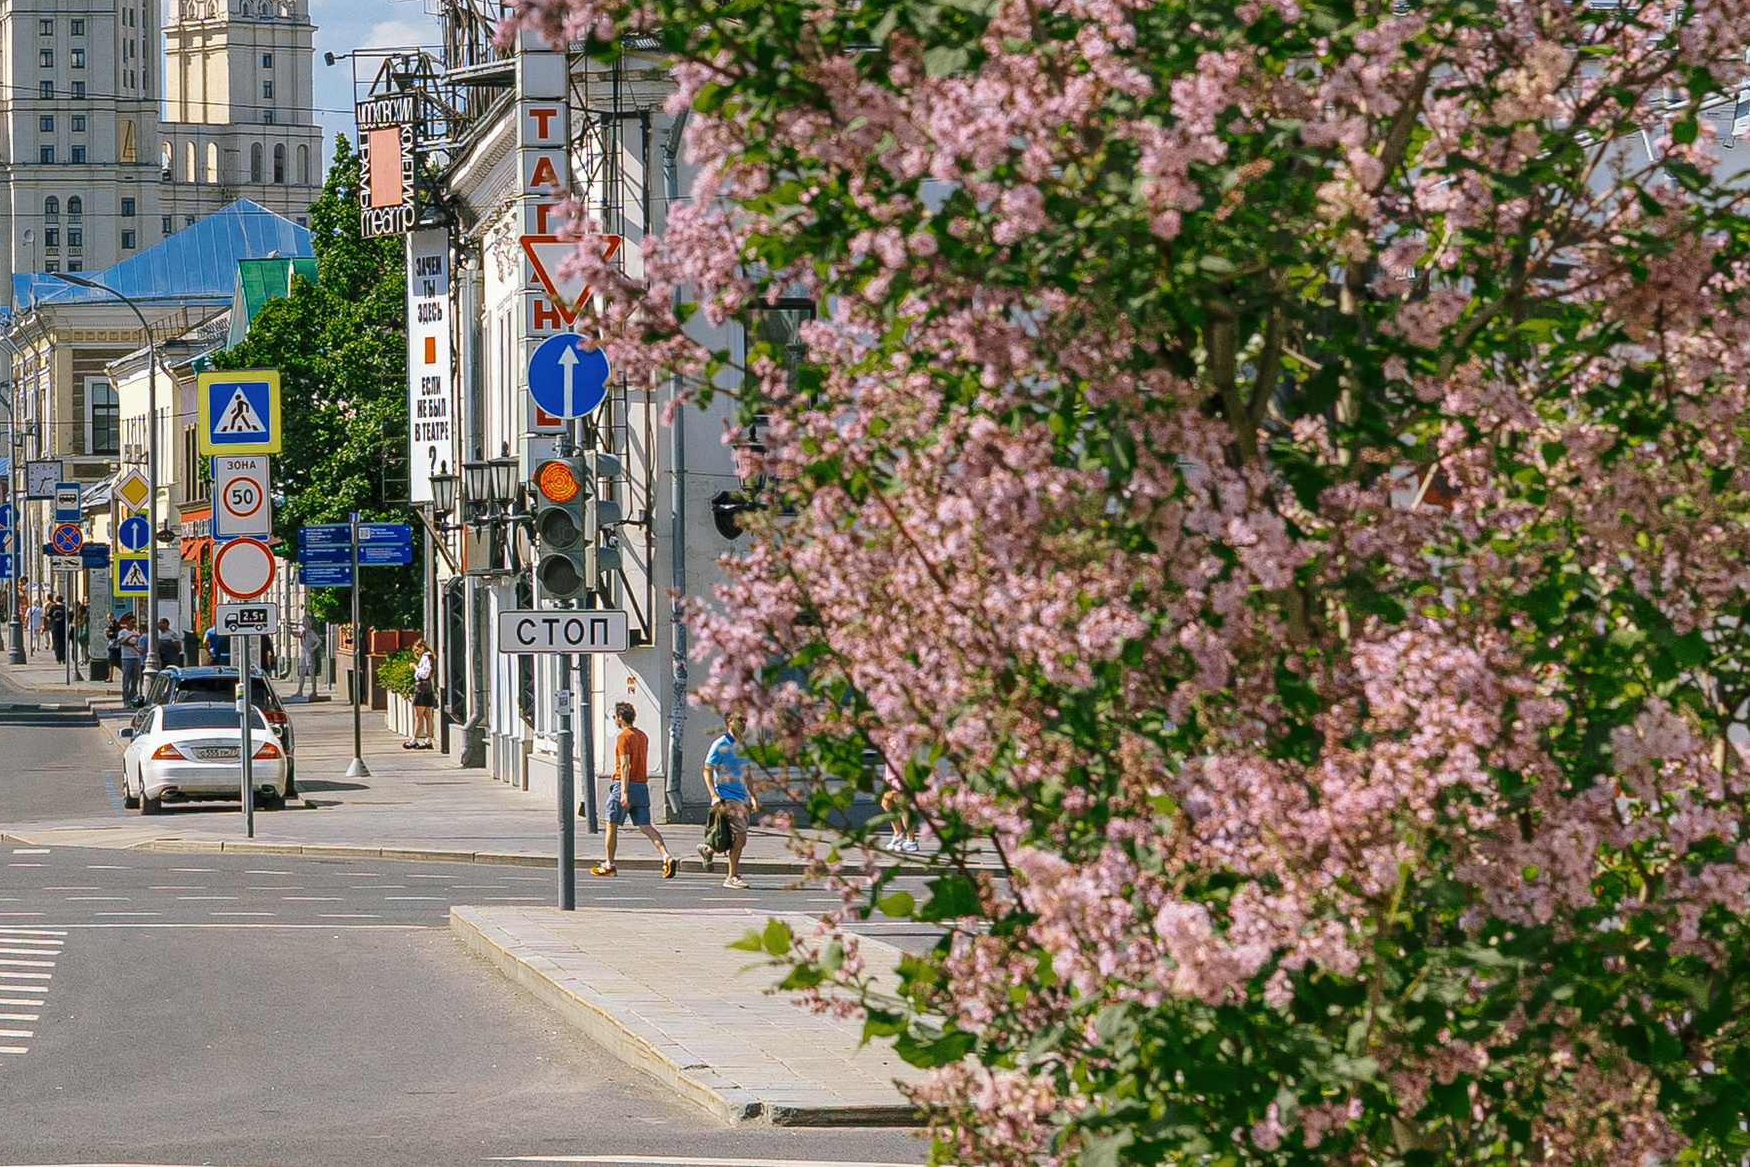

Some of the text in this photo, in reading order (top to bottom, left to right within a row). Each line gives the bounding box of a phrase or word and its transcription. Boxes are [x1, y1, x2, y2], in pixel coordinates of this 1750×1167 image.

[358, 130, 372, 210] ДРАМЫ
[416, 256, 442, 276] ЗАЧЕМ
[529, 109, 562, 426] ТАГН
[423, 280, 436, 298] ТЫ
[417, 302, 443, 324] ЗДЕСЬ
[421, 376, 441, 396] ЕСЛИ
[417, 398, 446, 418] НЕ БЫЛ
[415, 421, 449, 442] В ТЕАТРЕ
[227, 460, 256, 470] ЗОНА
[232, 489, 254, 505] 50
[516, 618, 609, 646] СТОП
